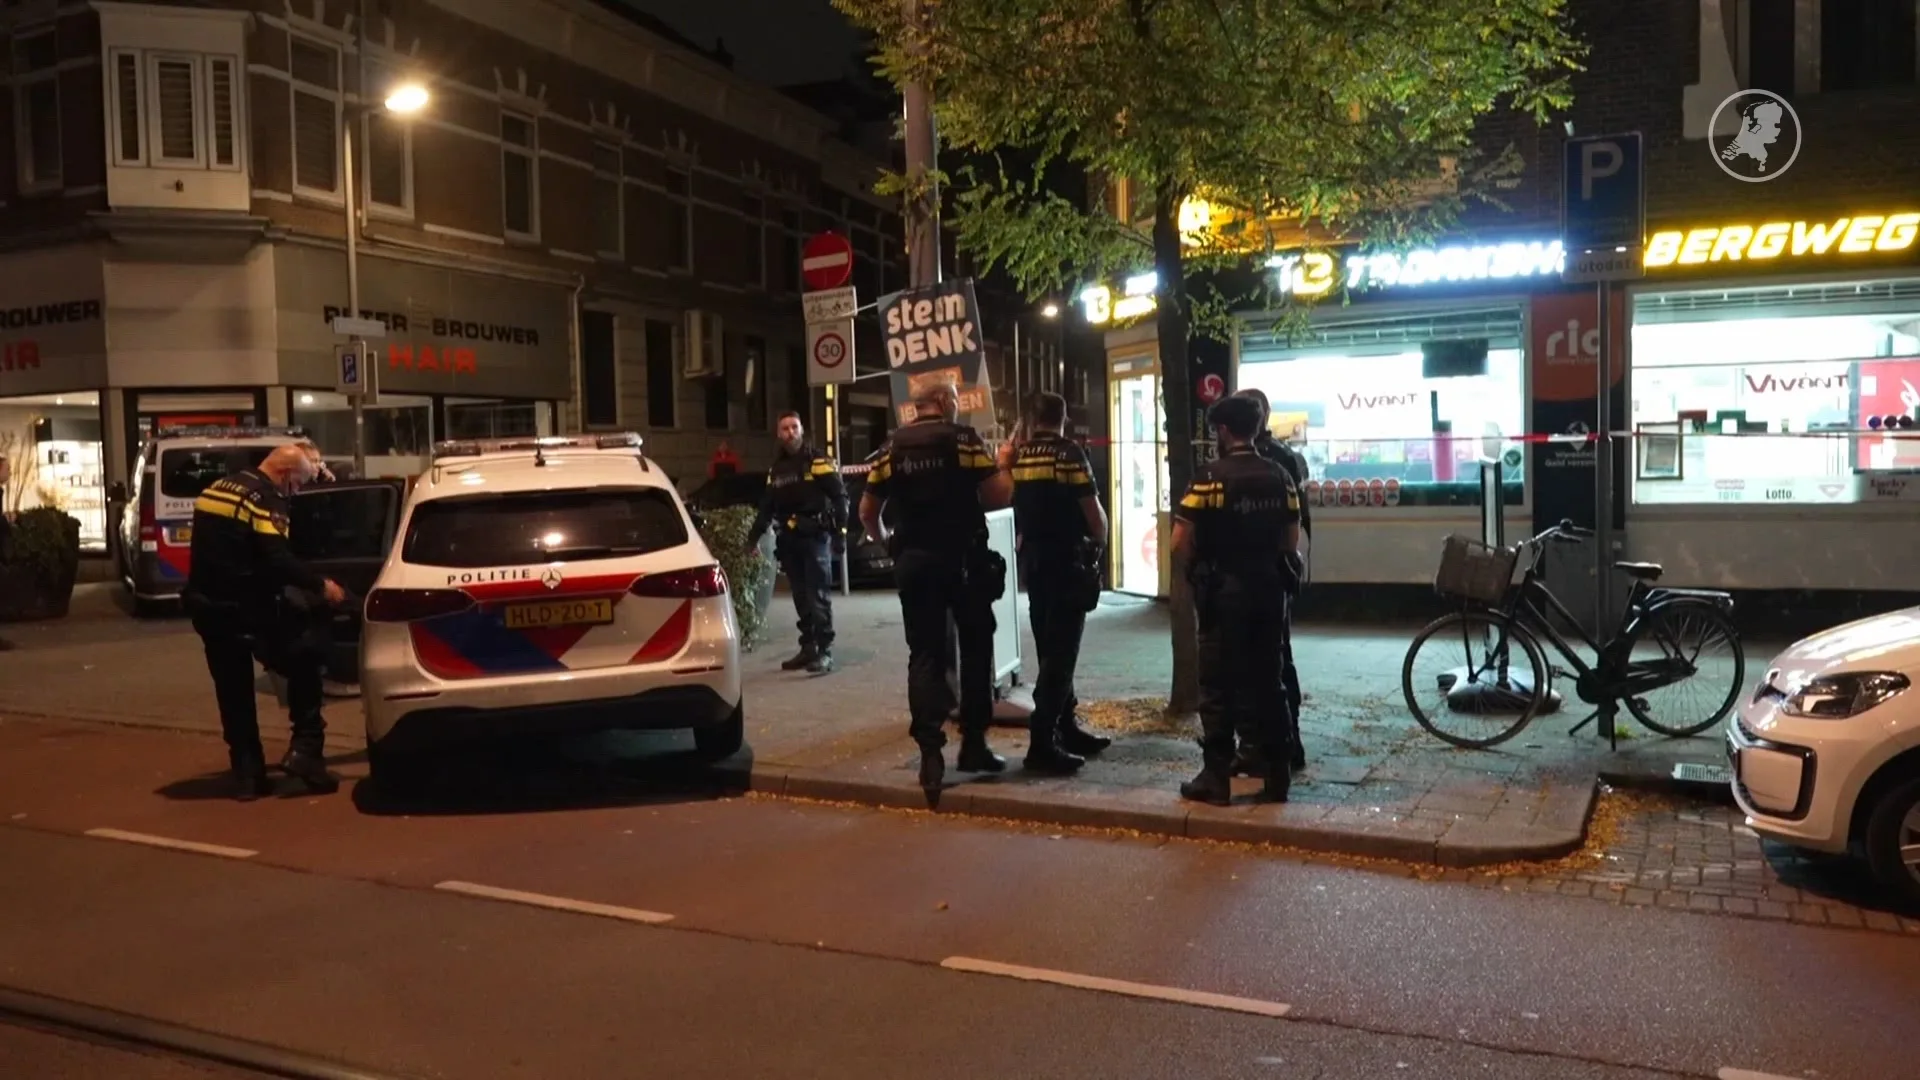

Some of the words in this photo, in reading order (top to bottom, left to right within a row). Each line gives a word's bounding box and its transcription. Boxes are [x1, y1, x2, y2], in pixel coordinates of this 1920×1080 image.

[1581, 141, 1624, 200] P
[1643, 213, 1920, 266] BERGWEG
[323, 305, 407, 331] PTER
[432, 317, 539, 346] BROUWER
[886, 293, 966, 334] stem
[0, 339, 41, 370] IR
[344, 355, 354, 367] P
[388, 343, 478, 375] HAIR
[821, 343, 840, 358] 30
[887, 321, 977, 368] DENK
[447, 568, 531, 585] POLITIE
